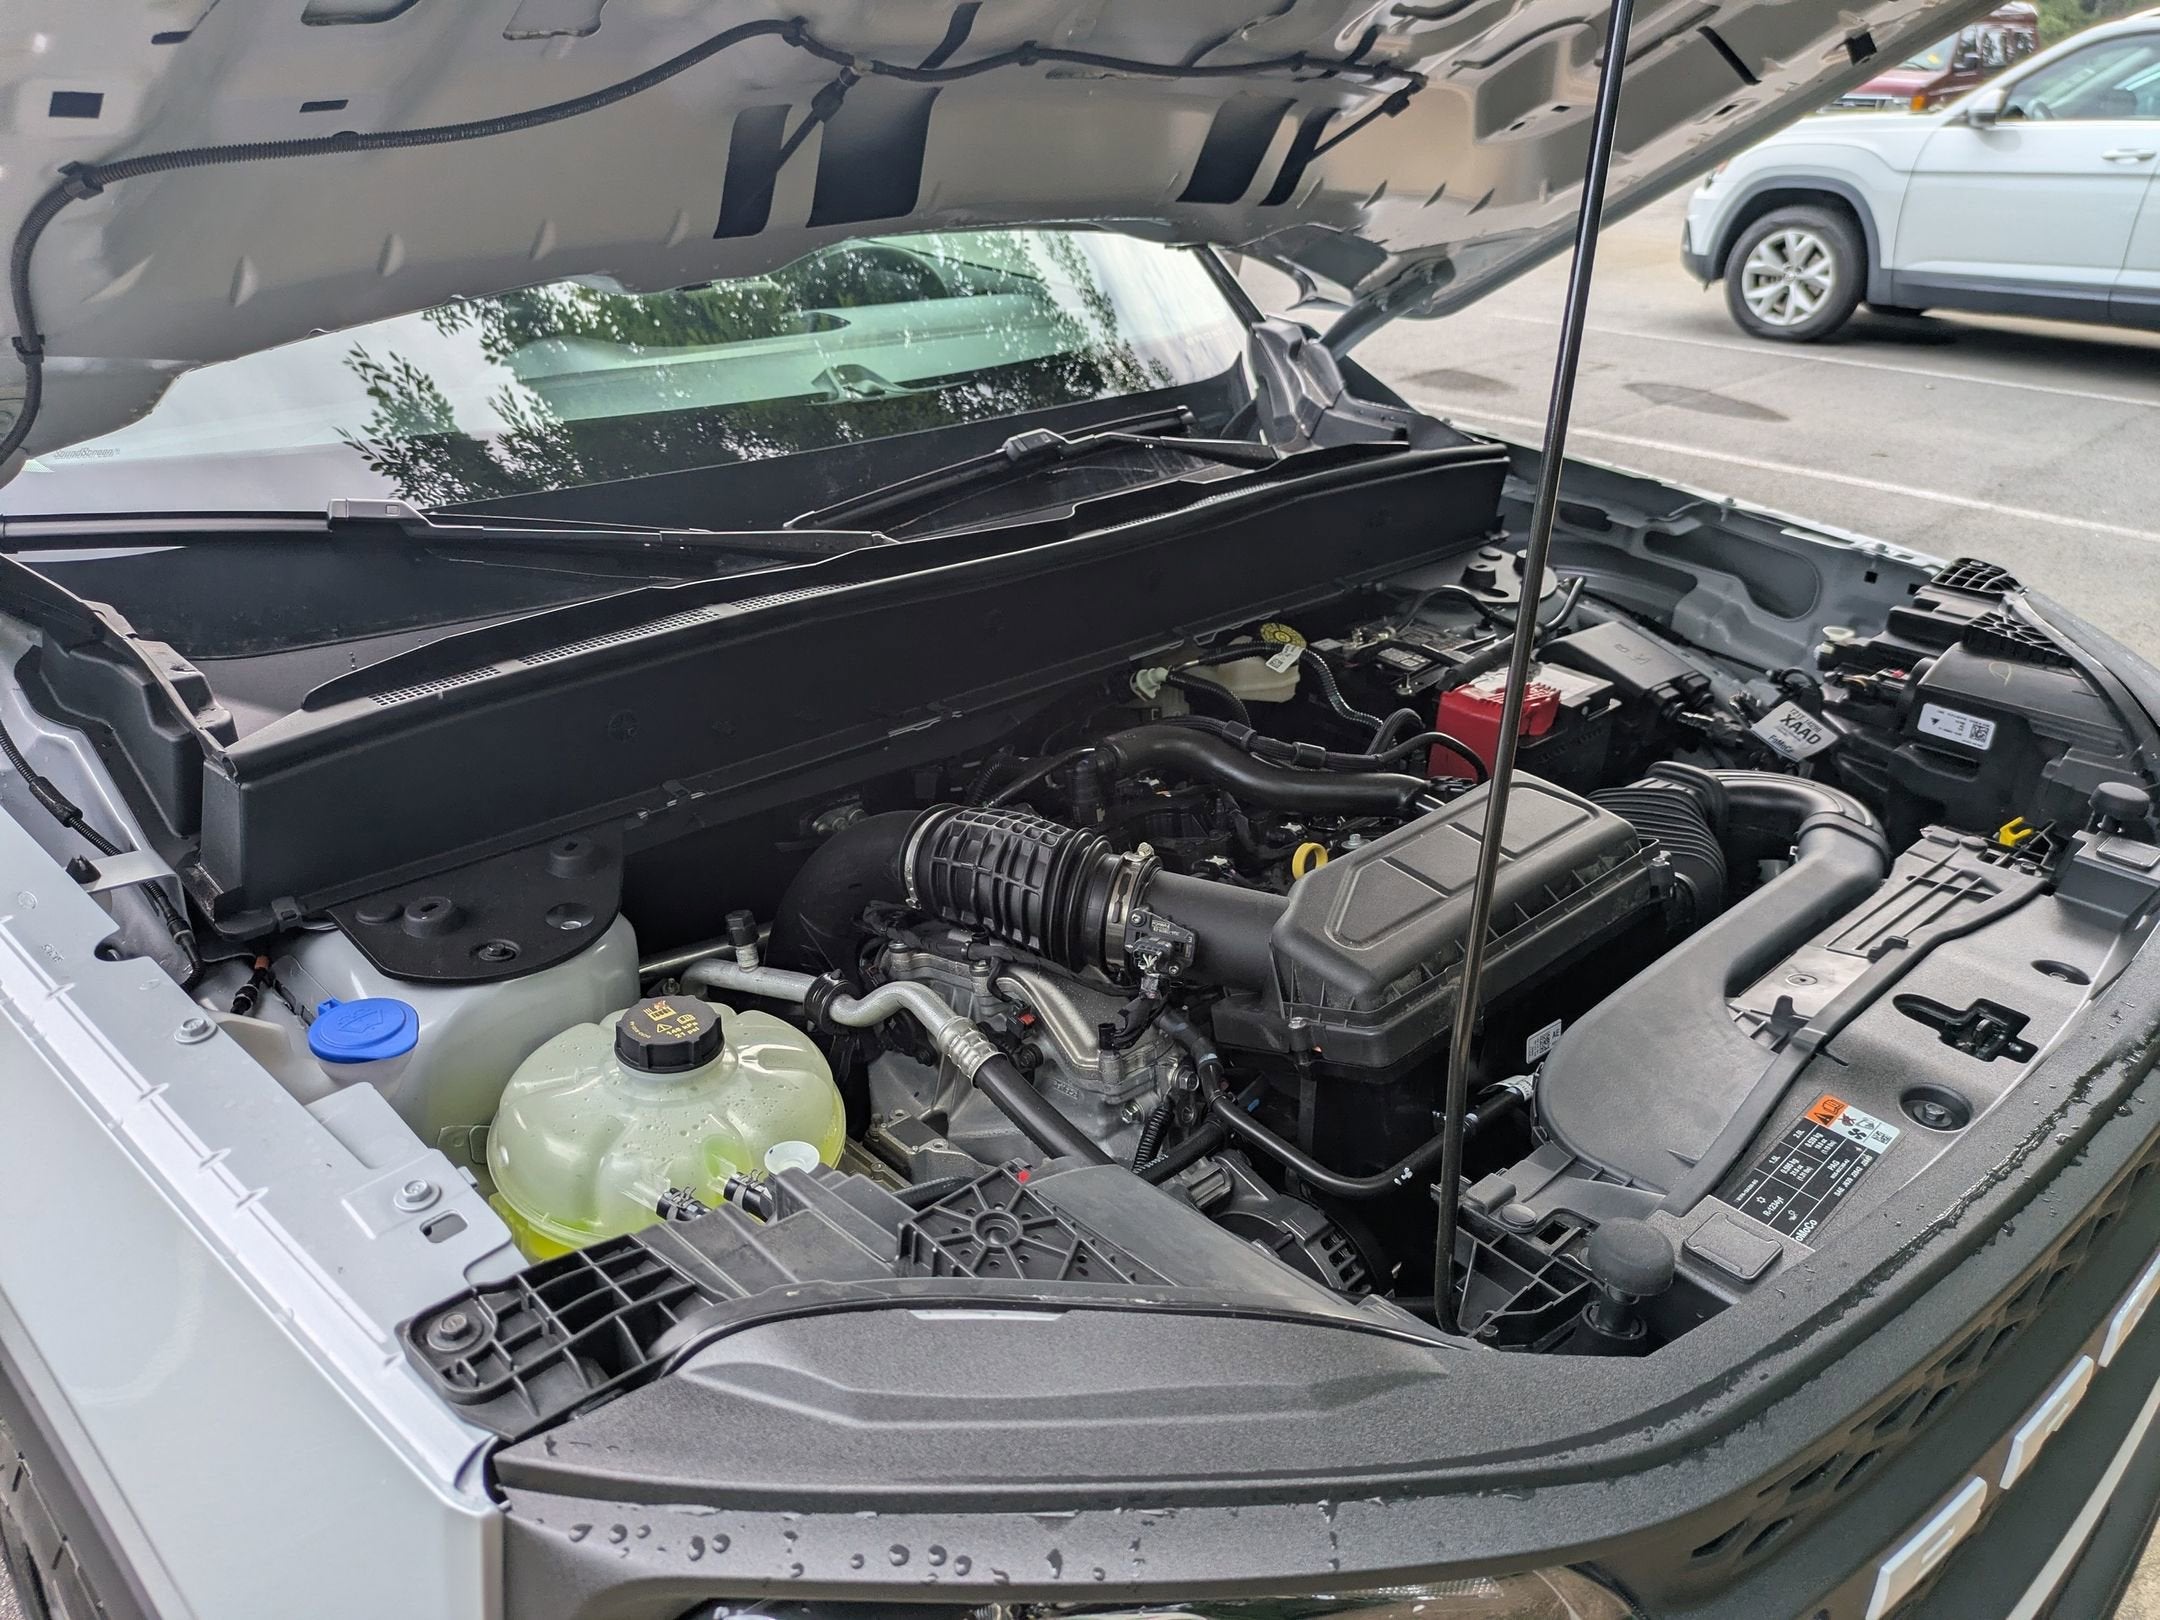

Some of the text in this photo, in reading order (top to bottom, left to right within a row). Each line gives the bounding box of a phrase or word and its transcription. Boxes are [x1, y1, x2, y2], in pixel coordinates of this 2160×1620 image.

[1780, 714, 1822, 745] XAAD
[1827, 1159, 1840, 1171] PAG
[1762, 1195, 1785, 1217] R-1234yf
[1794, 1219, 1818, 1241] oMoCo
